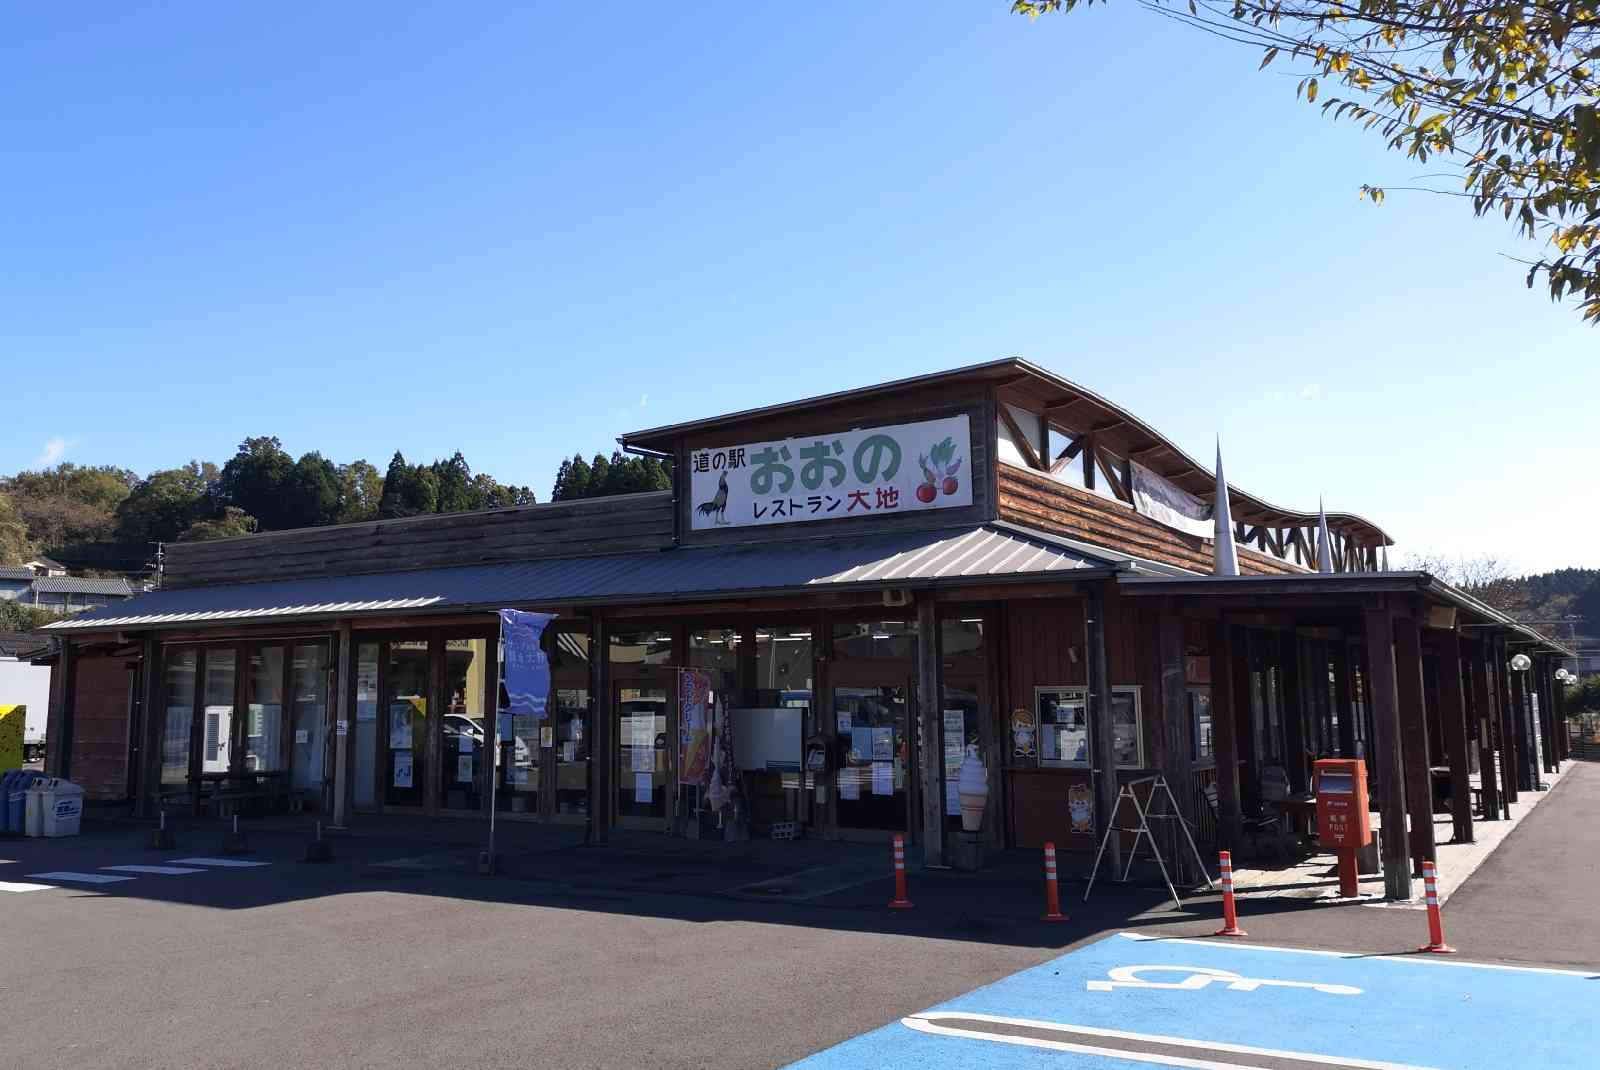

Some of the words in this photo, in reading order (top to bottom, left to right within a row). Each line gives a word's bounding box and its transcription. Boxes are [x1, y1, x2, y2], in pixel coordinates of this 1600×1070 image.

[693, 448, 747, 473] 道の駅
[751, 434, 902, 495] おおの
